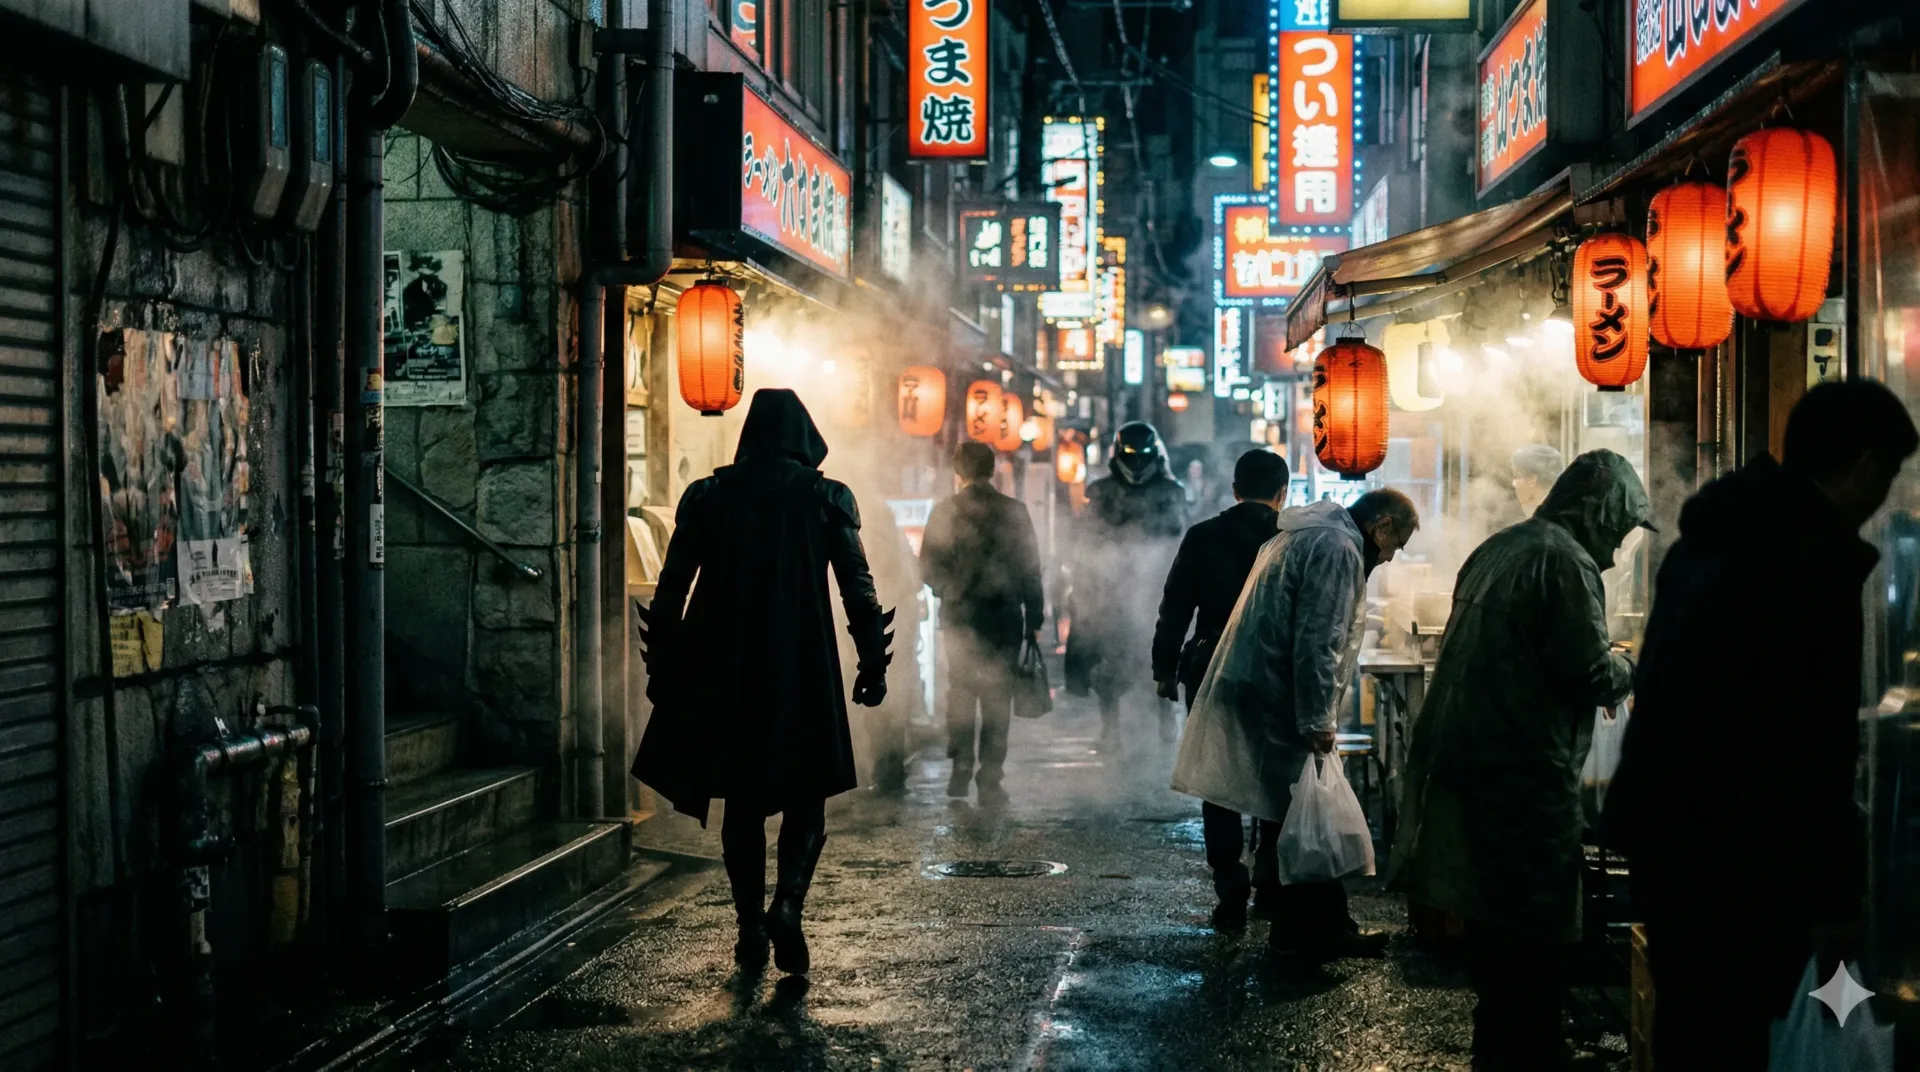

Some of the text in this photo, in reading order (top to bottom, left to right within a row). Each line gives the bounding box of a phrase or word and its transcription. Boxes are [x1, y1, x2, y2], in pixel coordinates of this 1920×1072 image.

[922, 0, 975, 144] つま焼
[1590, 255, 1630, 364] ラーメン
